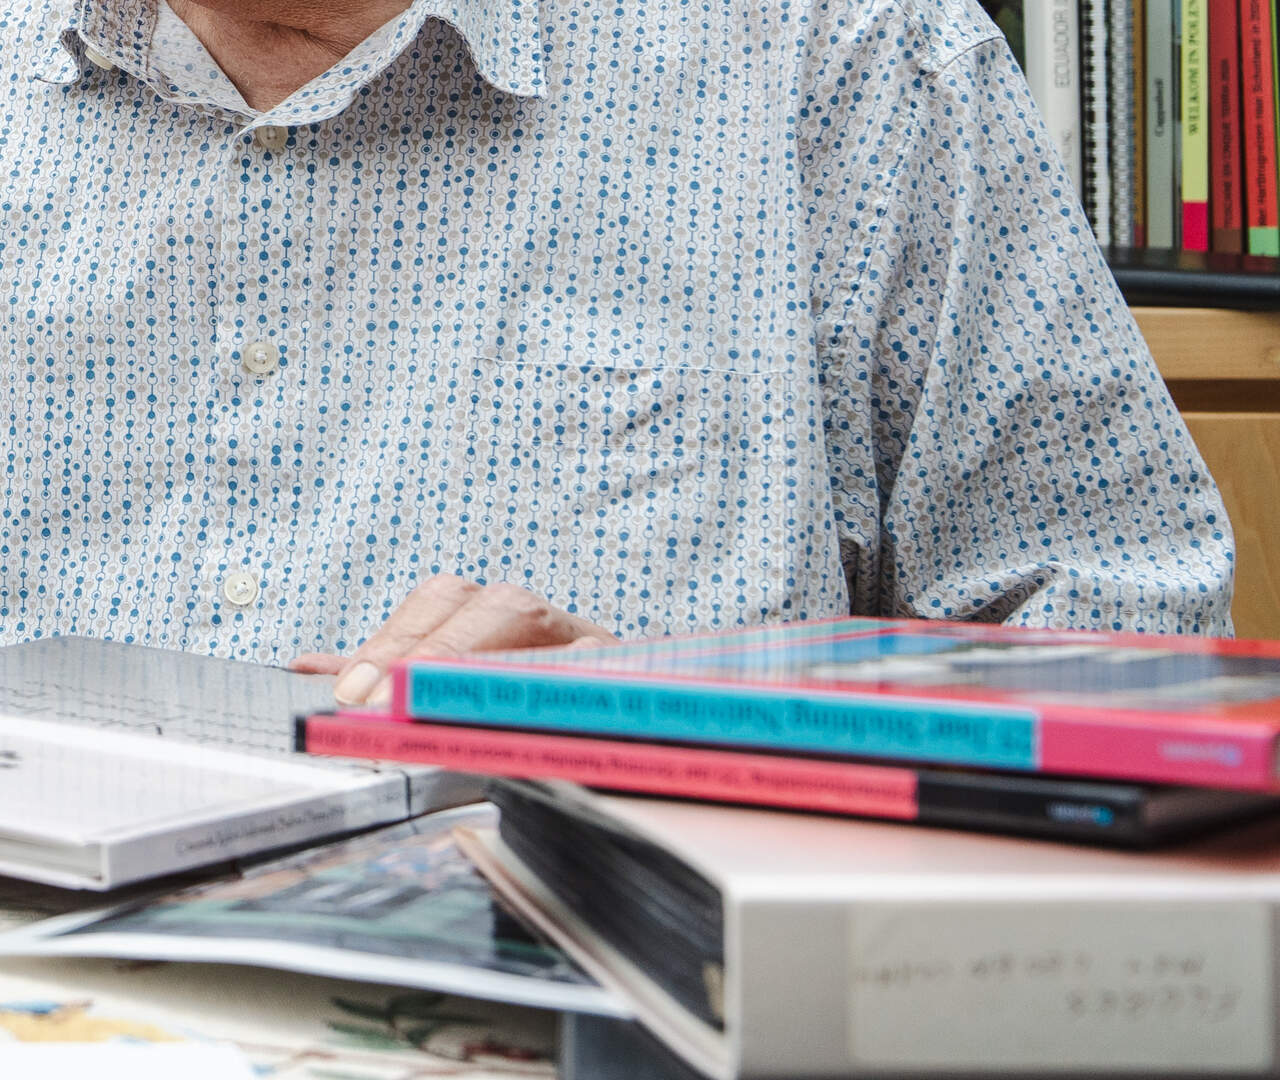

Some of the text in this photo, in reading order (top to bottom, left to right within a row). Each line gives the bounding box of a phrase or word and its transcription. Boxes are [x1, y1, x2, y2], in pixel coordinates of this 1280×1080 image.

[1053, 10, 1071, 89] ECUADOR
[1187, 47, 1200, 66] IN
[1187, 66, 1201, 137] WELKOM
[413, 678, 488, 713] beeld
[529, 686, 613, 717] woord
[793, 701, 924, 747] Stichting
